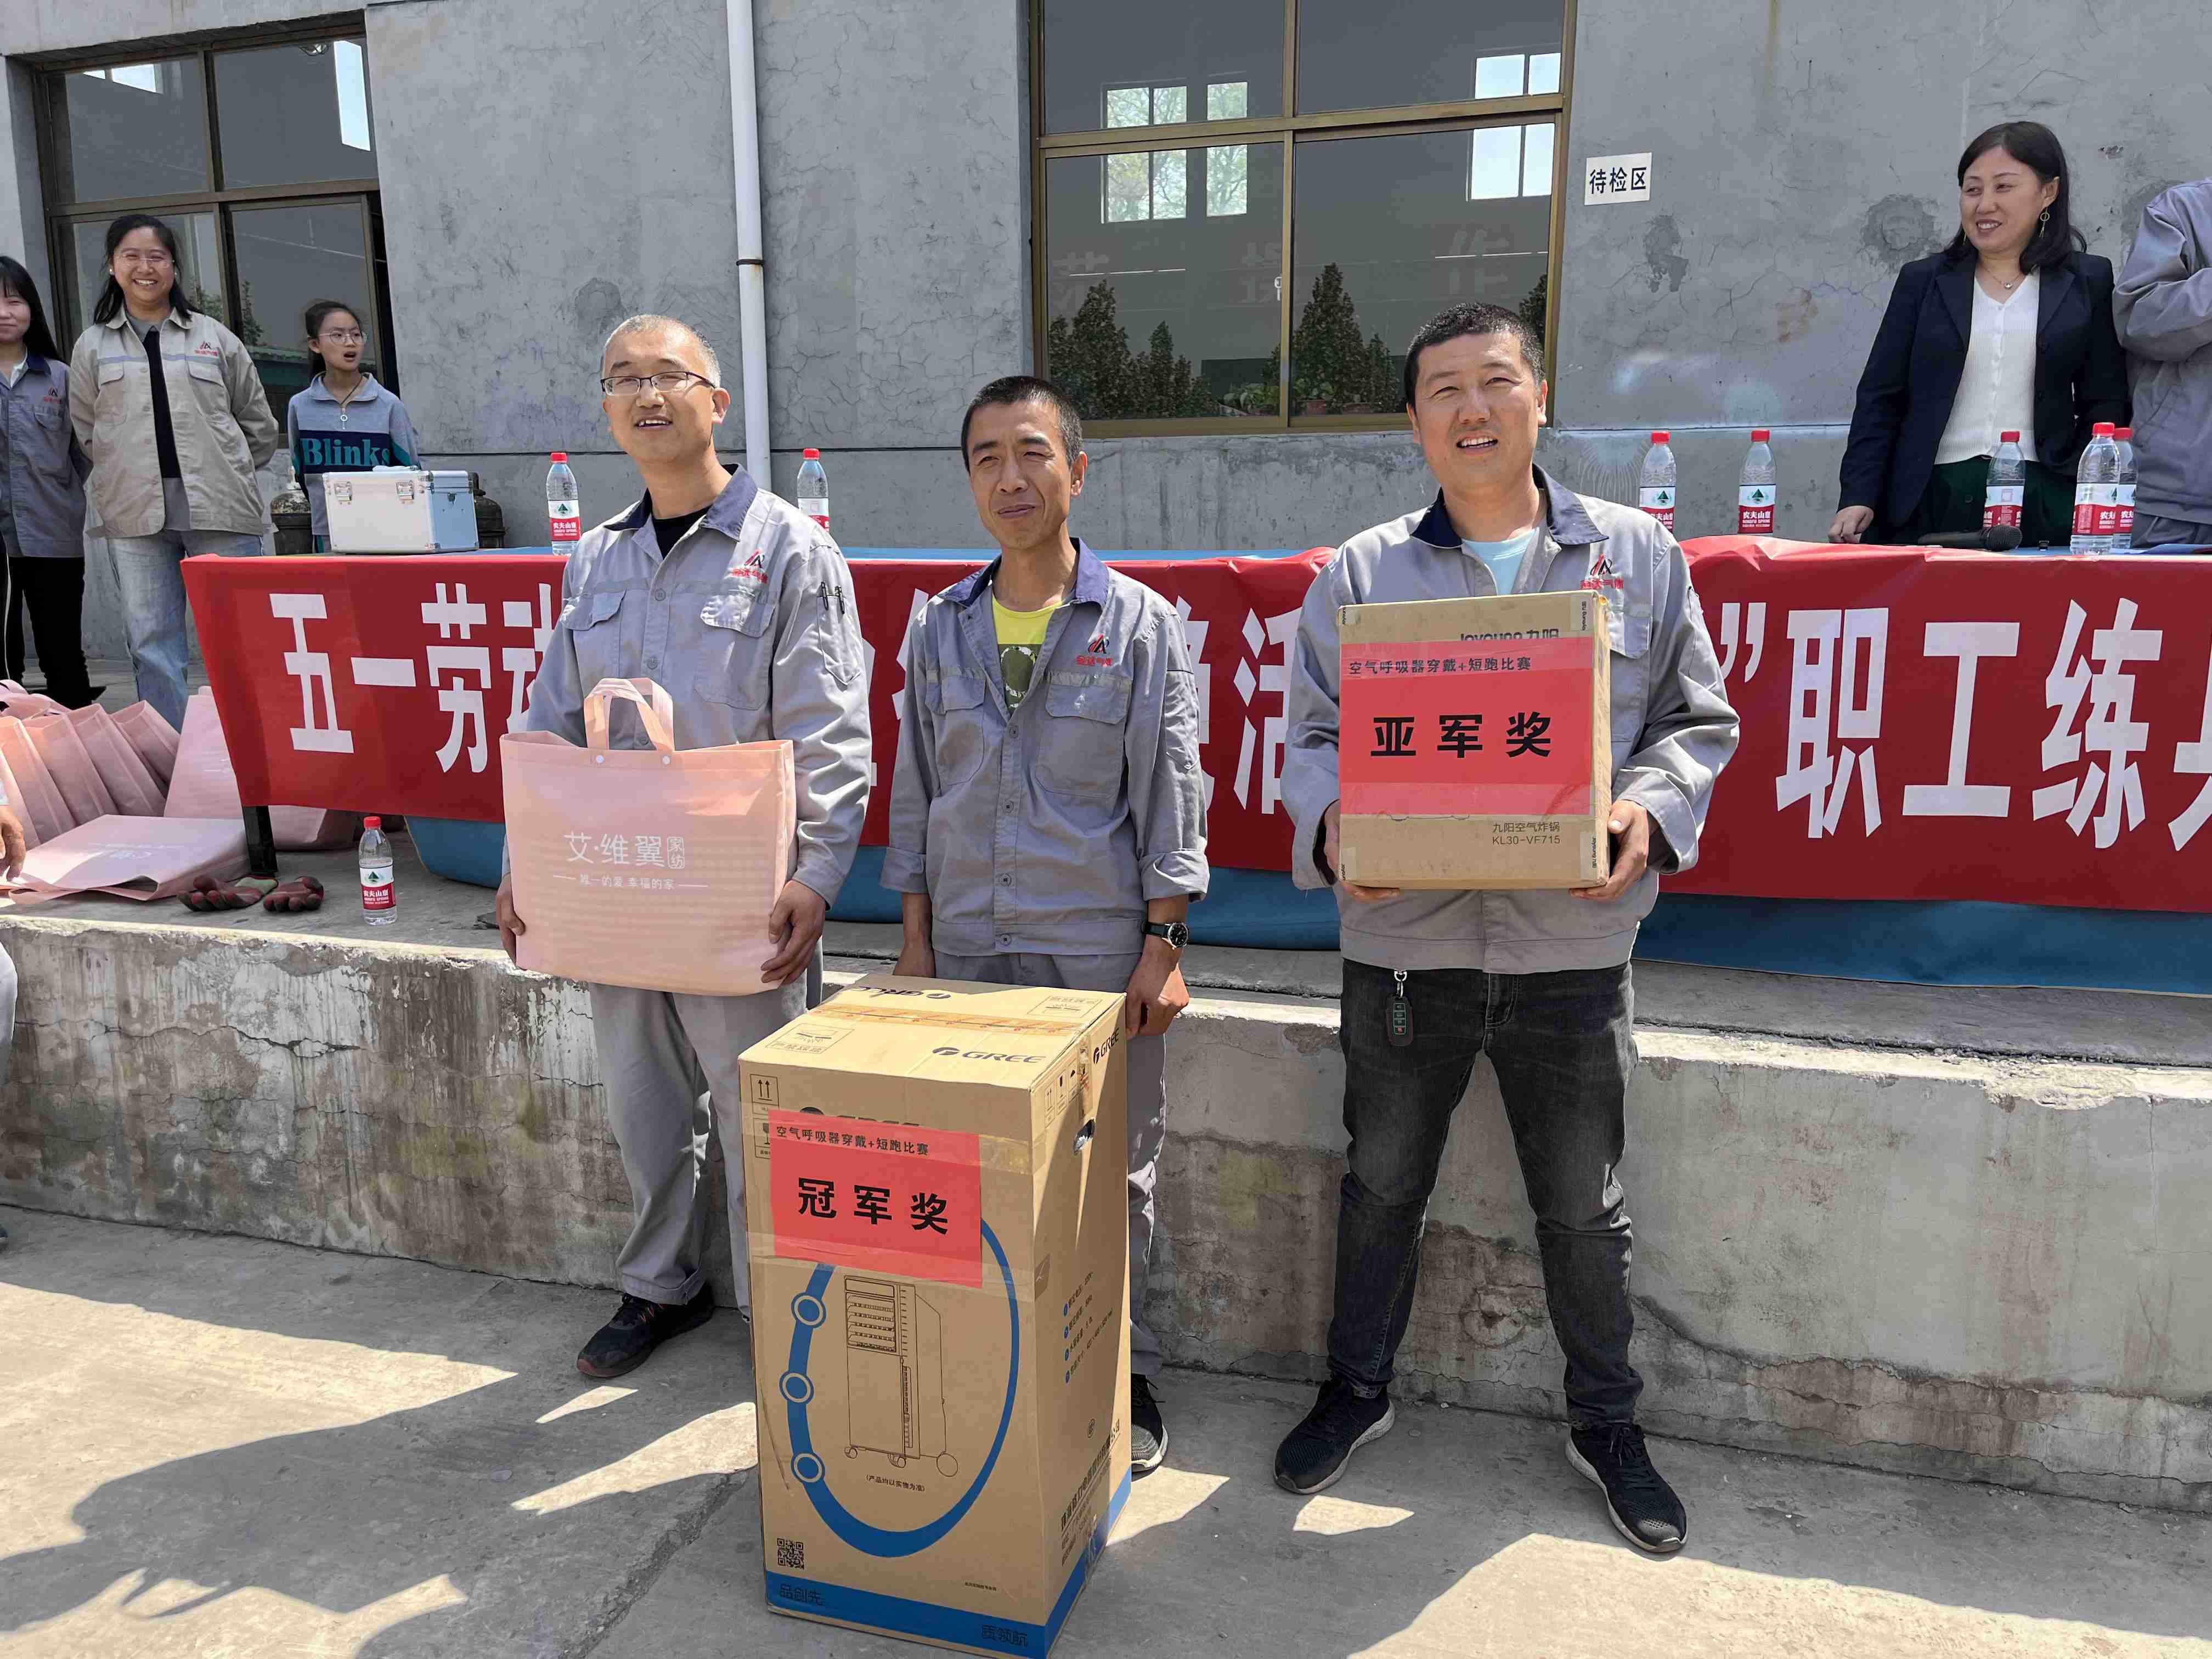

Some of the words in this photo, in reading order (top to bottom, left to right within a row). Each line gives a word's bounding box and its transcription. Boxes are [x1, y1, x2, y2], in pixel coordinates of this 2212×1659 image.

[1589, 167, 1646, 194] 待检区
[1651, 512, 1673, 521] 夫山
[1350, 657, 1532, 674] 空气呼吸器穿戴+短跑比赛
[1370, 711, 1551, 758] 亚军奖
[1722, 598, 2212, 851] ”职工练
[1492, 821, 1560, 833] 九阳空气炸锅
[1492, 836, 1561, 845] KL30-VF715
[1101, 1027, 1120, 1057] GREE
[962, 1051, 1046, 1063] GREE
[776, 1126, 929, 1156] 空气呼吸器穿戴+短跑比赛
[798, 1177, 948, 1235] 冠军奖
